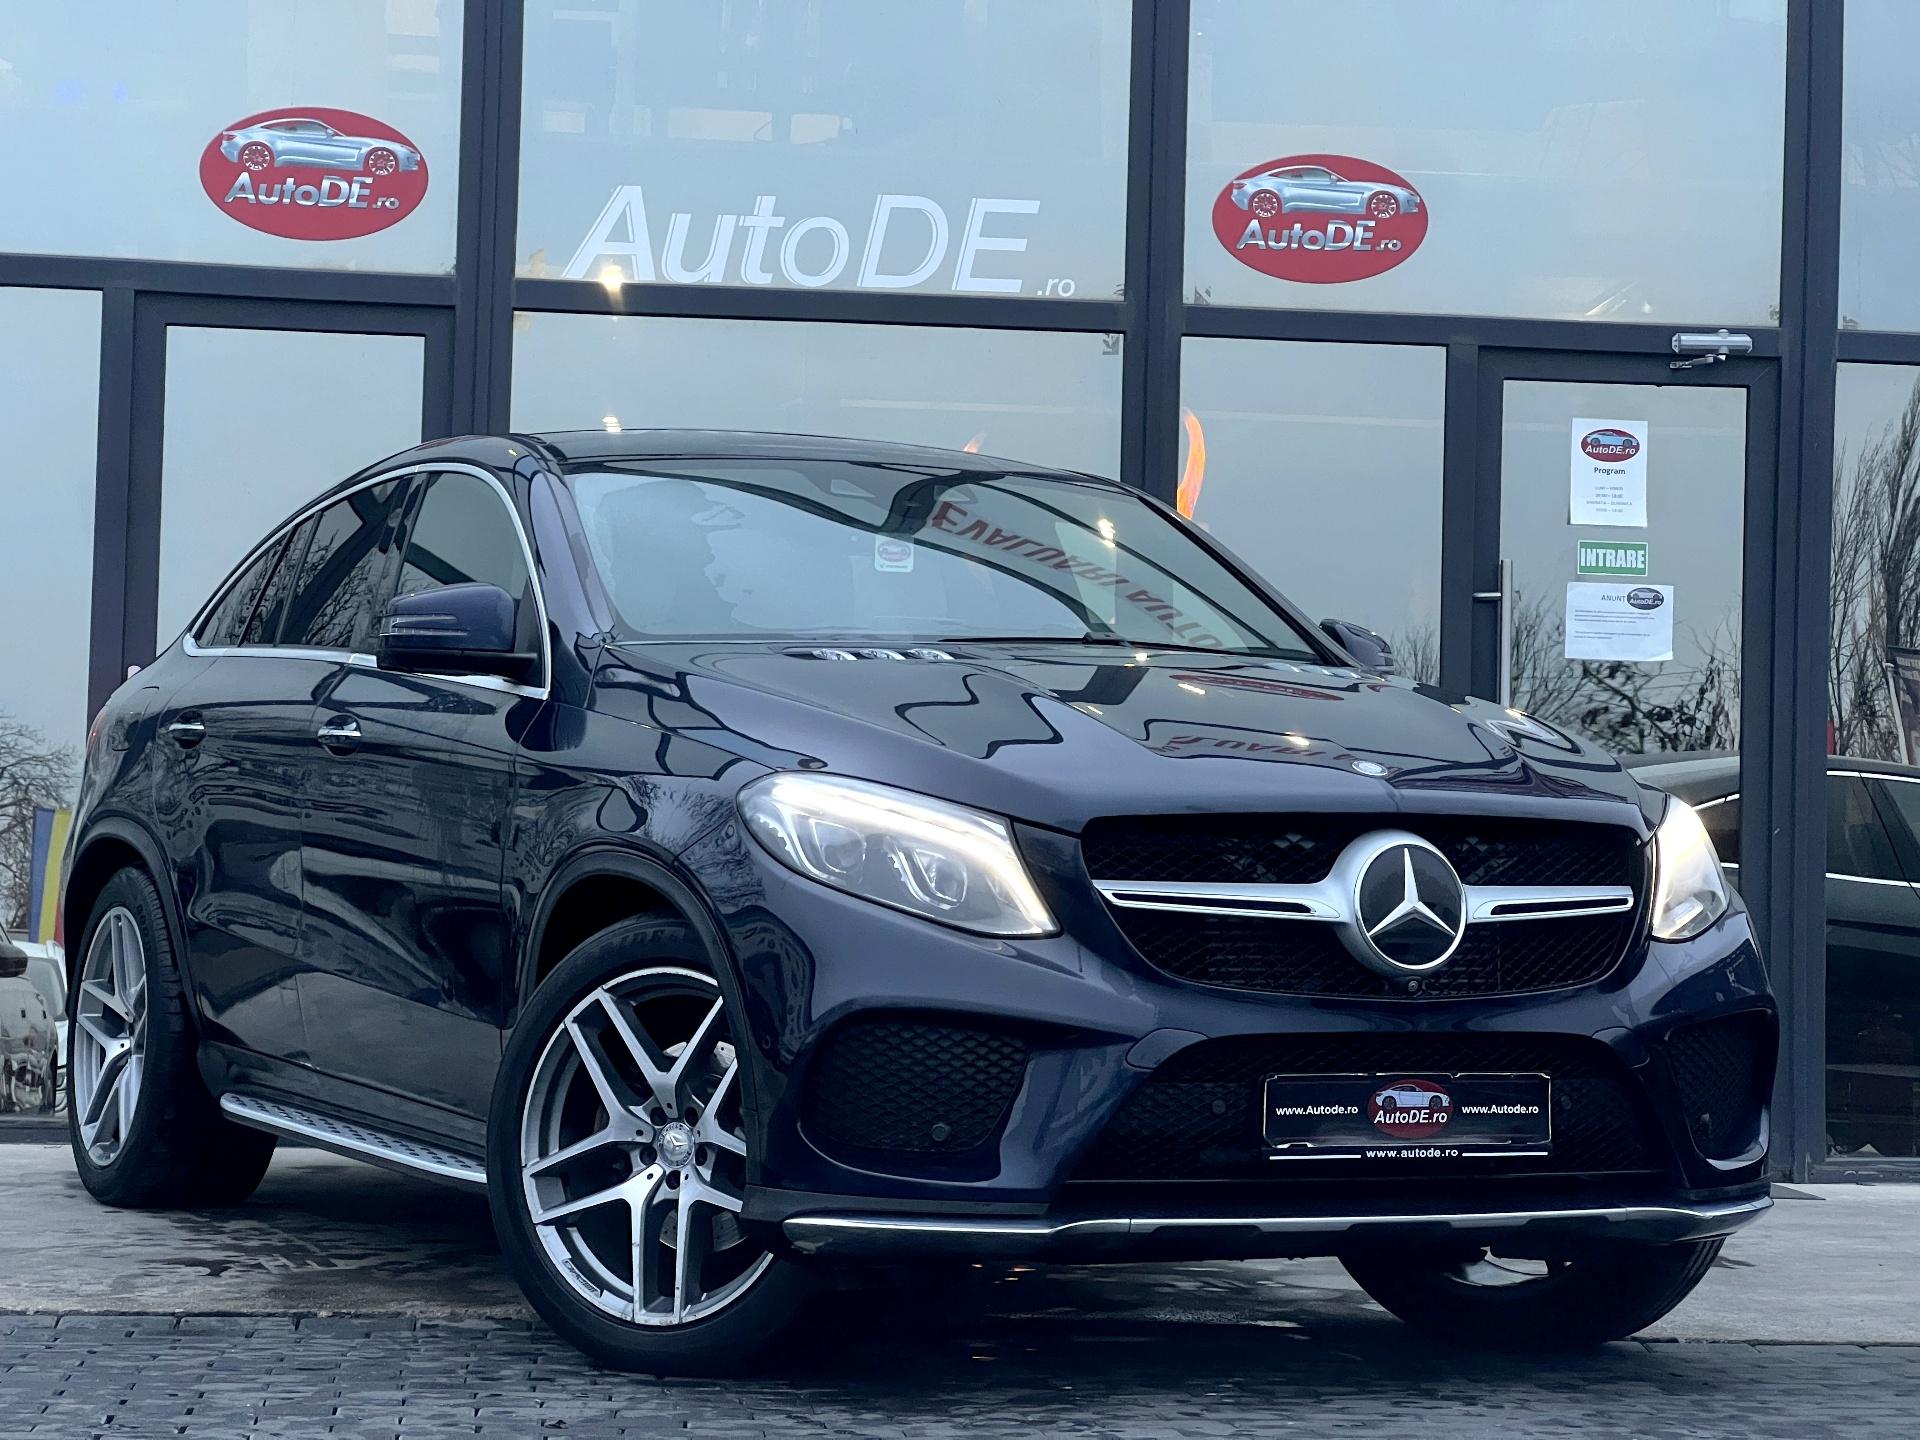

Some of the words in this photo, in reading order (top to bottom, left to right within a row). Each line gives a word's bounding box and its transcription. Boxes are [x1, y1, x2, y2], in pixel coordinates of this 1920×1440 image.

[1585, 445, 1636, 455] AutoDE.ro
[1594, 467, 1626, 475] Program
[1580, 548, 1645, 569] INTRARE
[1276, 1105, 1358, 1116] www.Autode.ro
[1374, 1110, 1448, 1124] AutoDE.ro
[1461, 1104, 1539, 1115] www.Autode.ro
[1366, 1148, 1459, 1159] www.autode.ro
